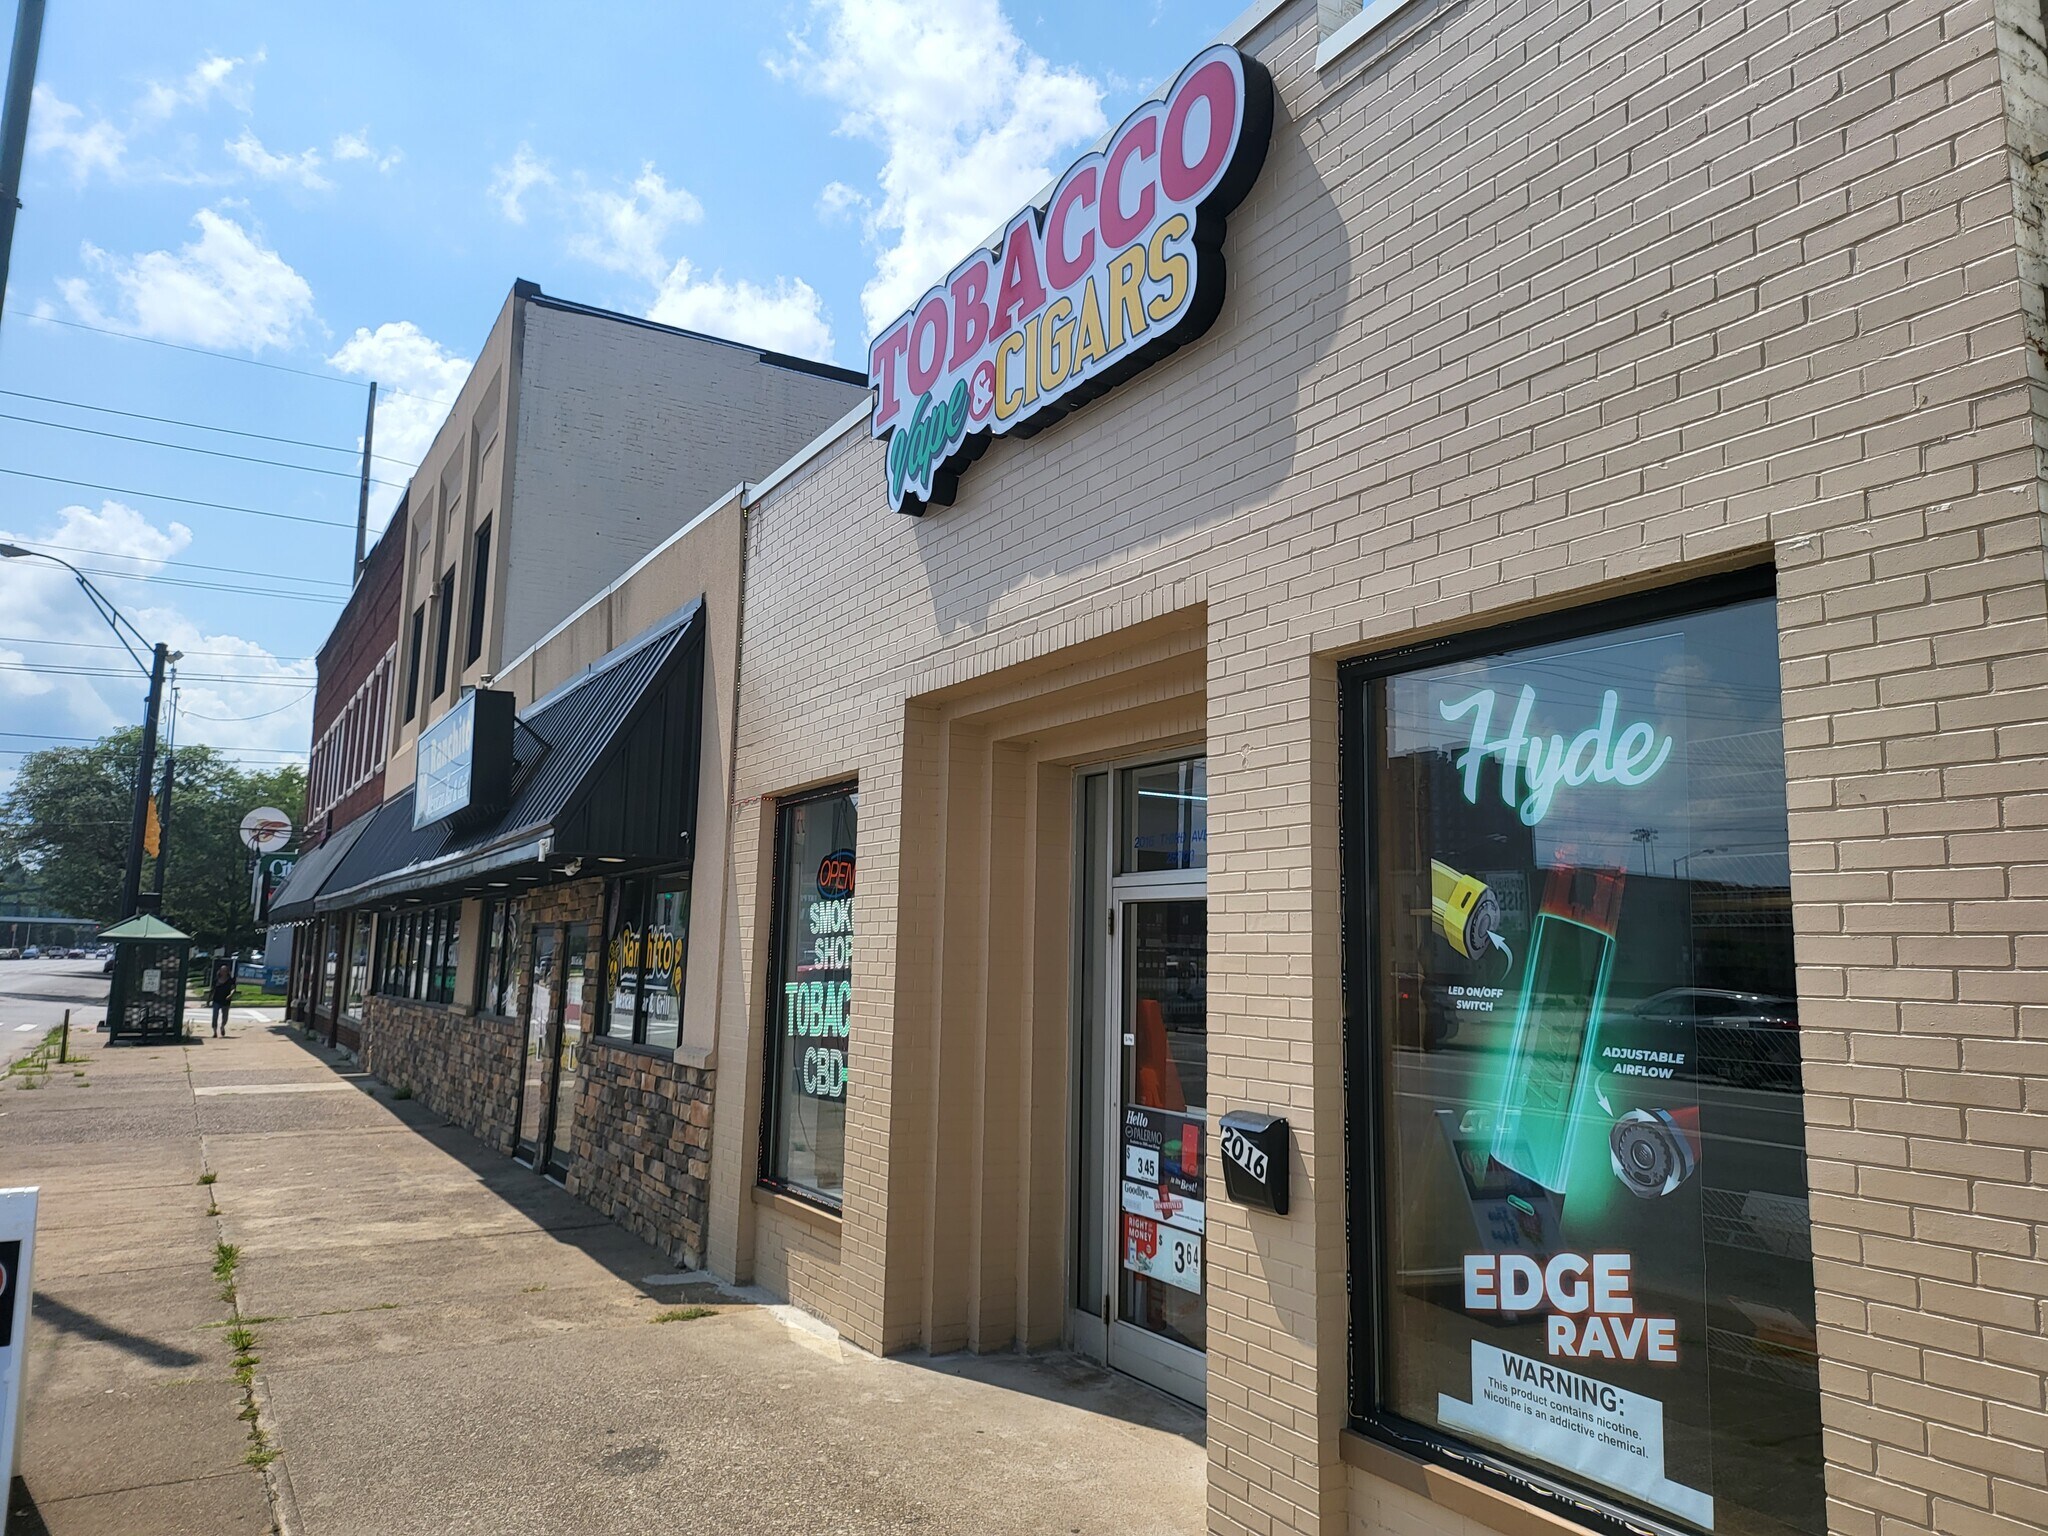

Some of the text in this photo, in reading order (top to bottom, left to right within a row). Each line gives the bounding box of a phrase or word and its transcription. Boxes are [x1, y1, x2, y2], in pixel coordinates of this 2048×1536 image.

[872, 60, 1236, 427] TOBACCO
[890, 212, 1189, 497] Vape & CIGARS
[1440, 684, 1672, 826] Hyde
[820, 860, 856, 891] OPEN
[621, 926, 672, 971] Ranhito
[814, 935, 854, 970] SHOP
[615, 988, 636, 1011] Mexica
[656, 995, 670, 1015] Grill
[785, 981, 852, 1037] TOBAC
[1448, 986, 1504, 998] LED ON/OFF
[1456, 999, 1494, 1012] SWITCH
[803, 1046, 843, 1097] CBD
[1602, 1046, 1685, 1065] ADJUSTABLE
[1613, 1063, 1674, 1079] AIRFLOW
[1126, 1110, 1149, 1128] Hello
[1133, 1126, 1163, 1145] PALERMO
[1221, 1126, 1265, 1179] 2016
[1128, 1216, 1149, 1231] RIGHT
[1128, 1227, 1153, 1243] MONEY
[1464, 1253, 1634, 1314] EDGE
[1547, 1314, 1678, 1363] RAVE
[1502, 1353, 1625, 1417] WARNING:
[1483, 1388, 1650, 1460] Nicotine is an addictive chemical.
[1488, 1376, 1643, 1441] This product contains nicotine.
